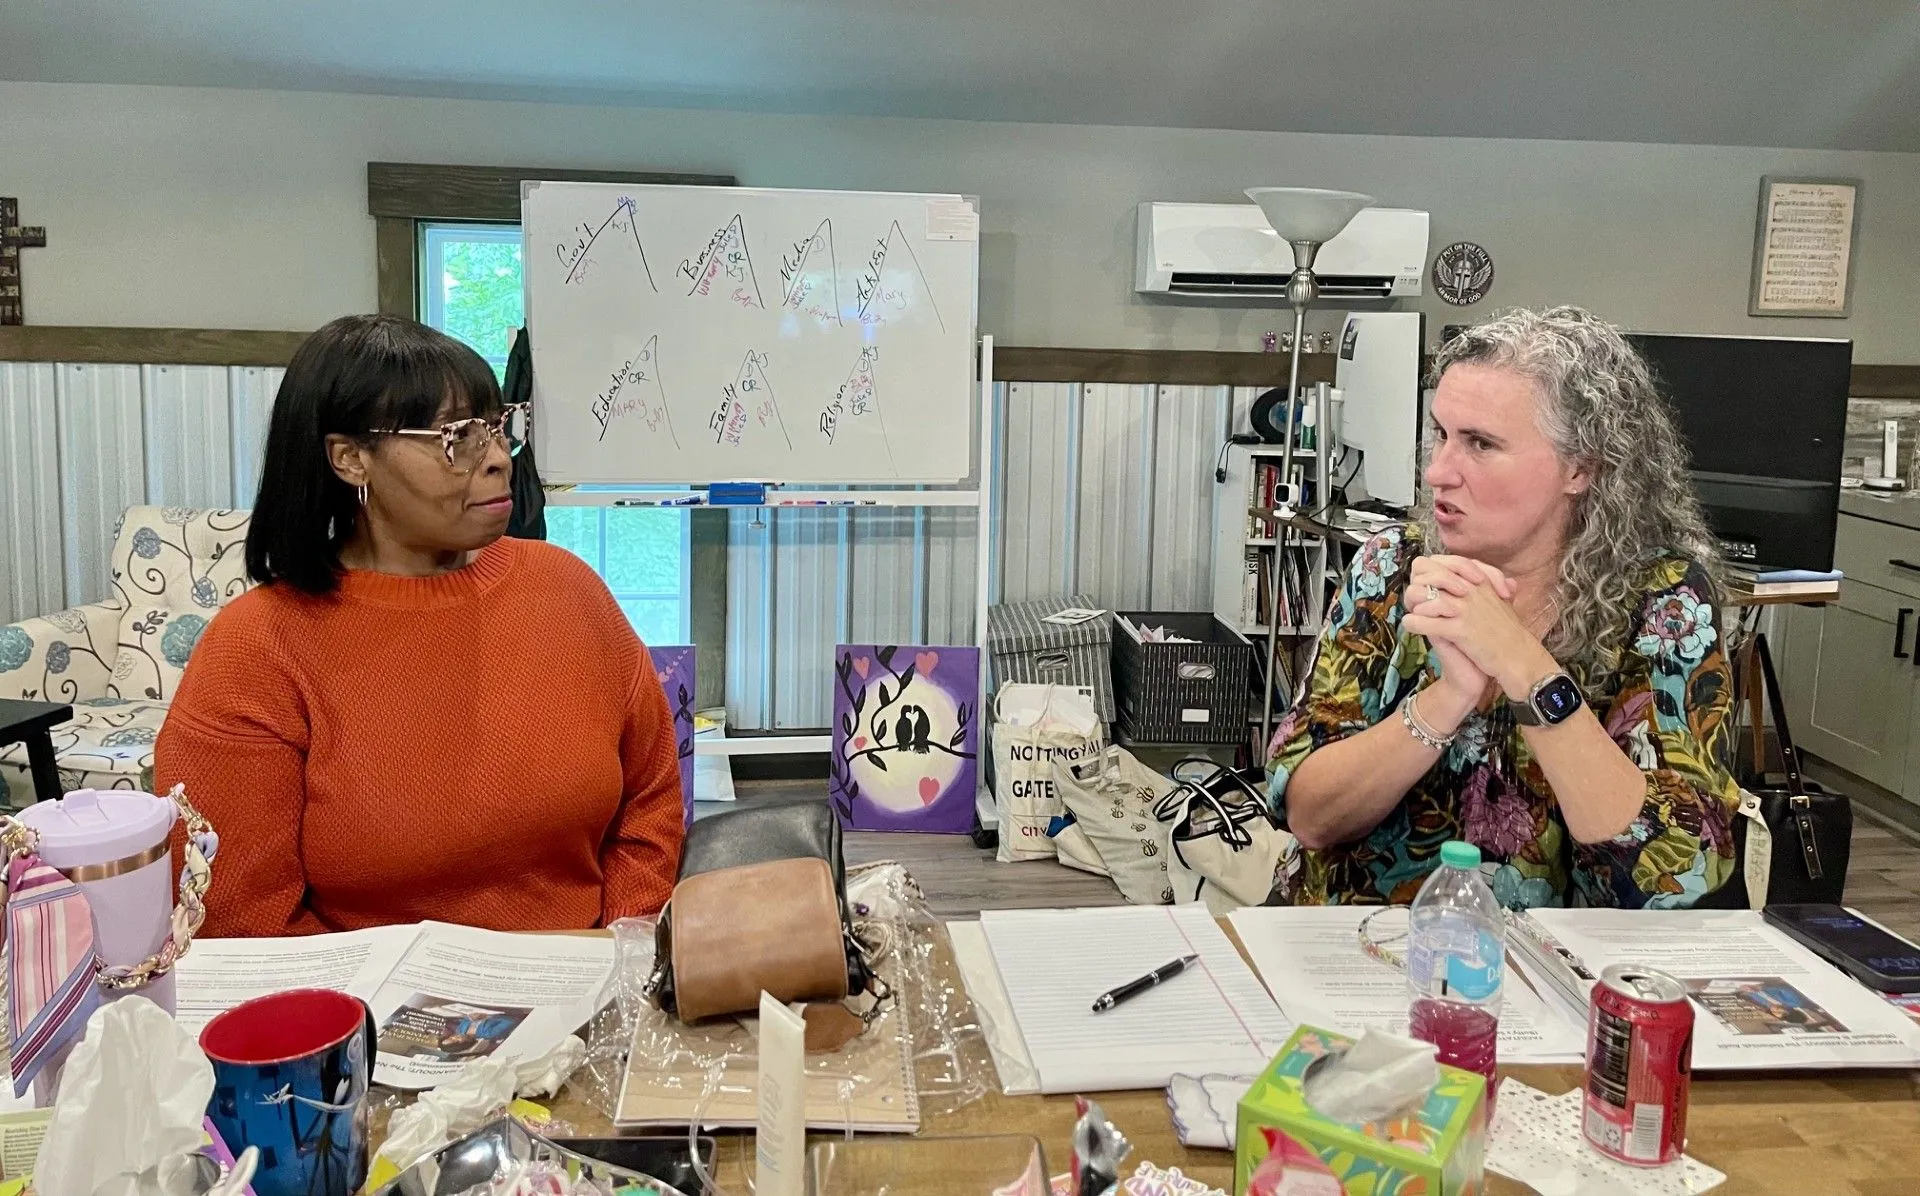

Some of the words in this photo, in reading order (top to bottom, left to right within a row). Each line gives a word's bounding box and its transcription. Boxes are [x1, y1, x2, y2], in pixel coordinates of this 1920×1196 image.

[1442, 247, 1453, 257] PUT
[1475, 248, 1488, 262] FULL
[780, 236, 815, 299] Media
[1437, 286, 1458, 304] ARMOR
[1468, 292, 1481, 303] GOD
[591, 360, 632, 426] Education
[709, 384, 738, 432] Family
[1012, 780, 1054, 798] GATE
[1021, 826, 1047, 837] CITY
